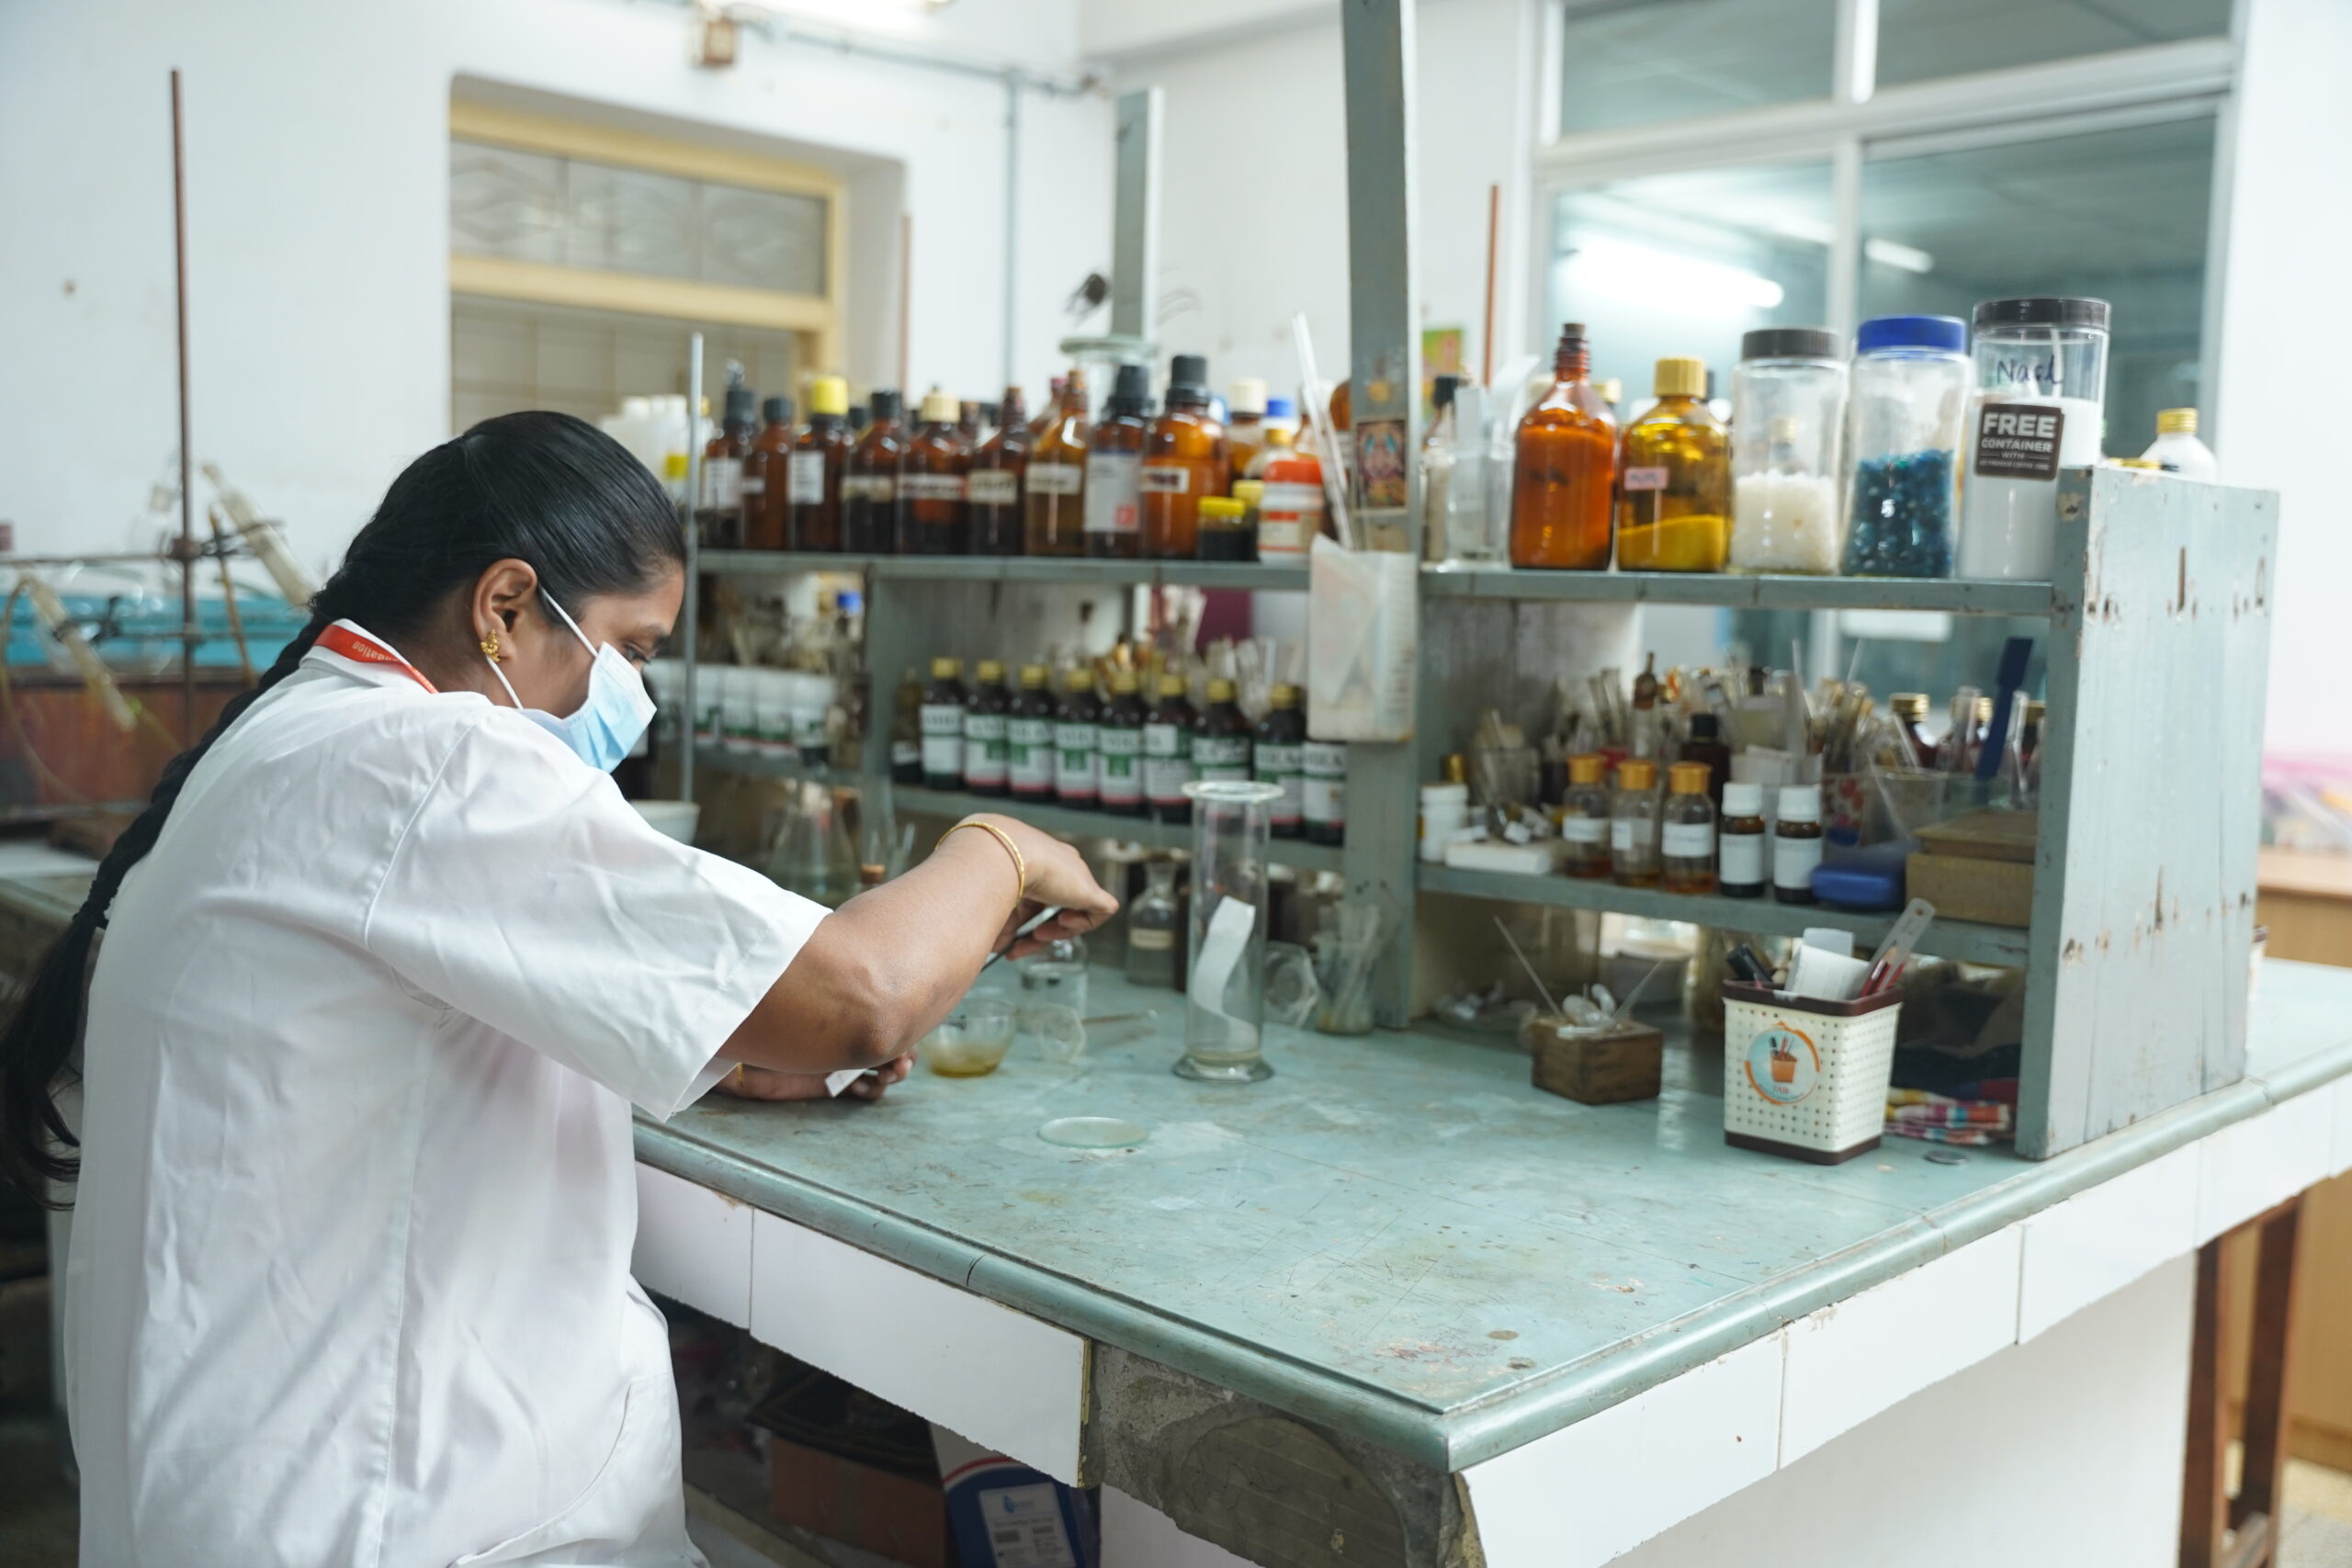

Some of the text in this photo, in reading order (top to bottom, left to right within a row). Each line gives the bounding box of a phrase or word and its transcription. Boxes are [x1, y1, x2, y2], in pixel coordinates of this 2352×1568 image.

[1983, 412, 2056, 438] FREE
[1981, 438, 2052, 452] CONTAINER
[2001, 451, 2025, 459] WITH
